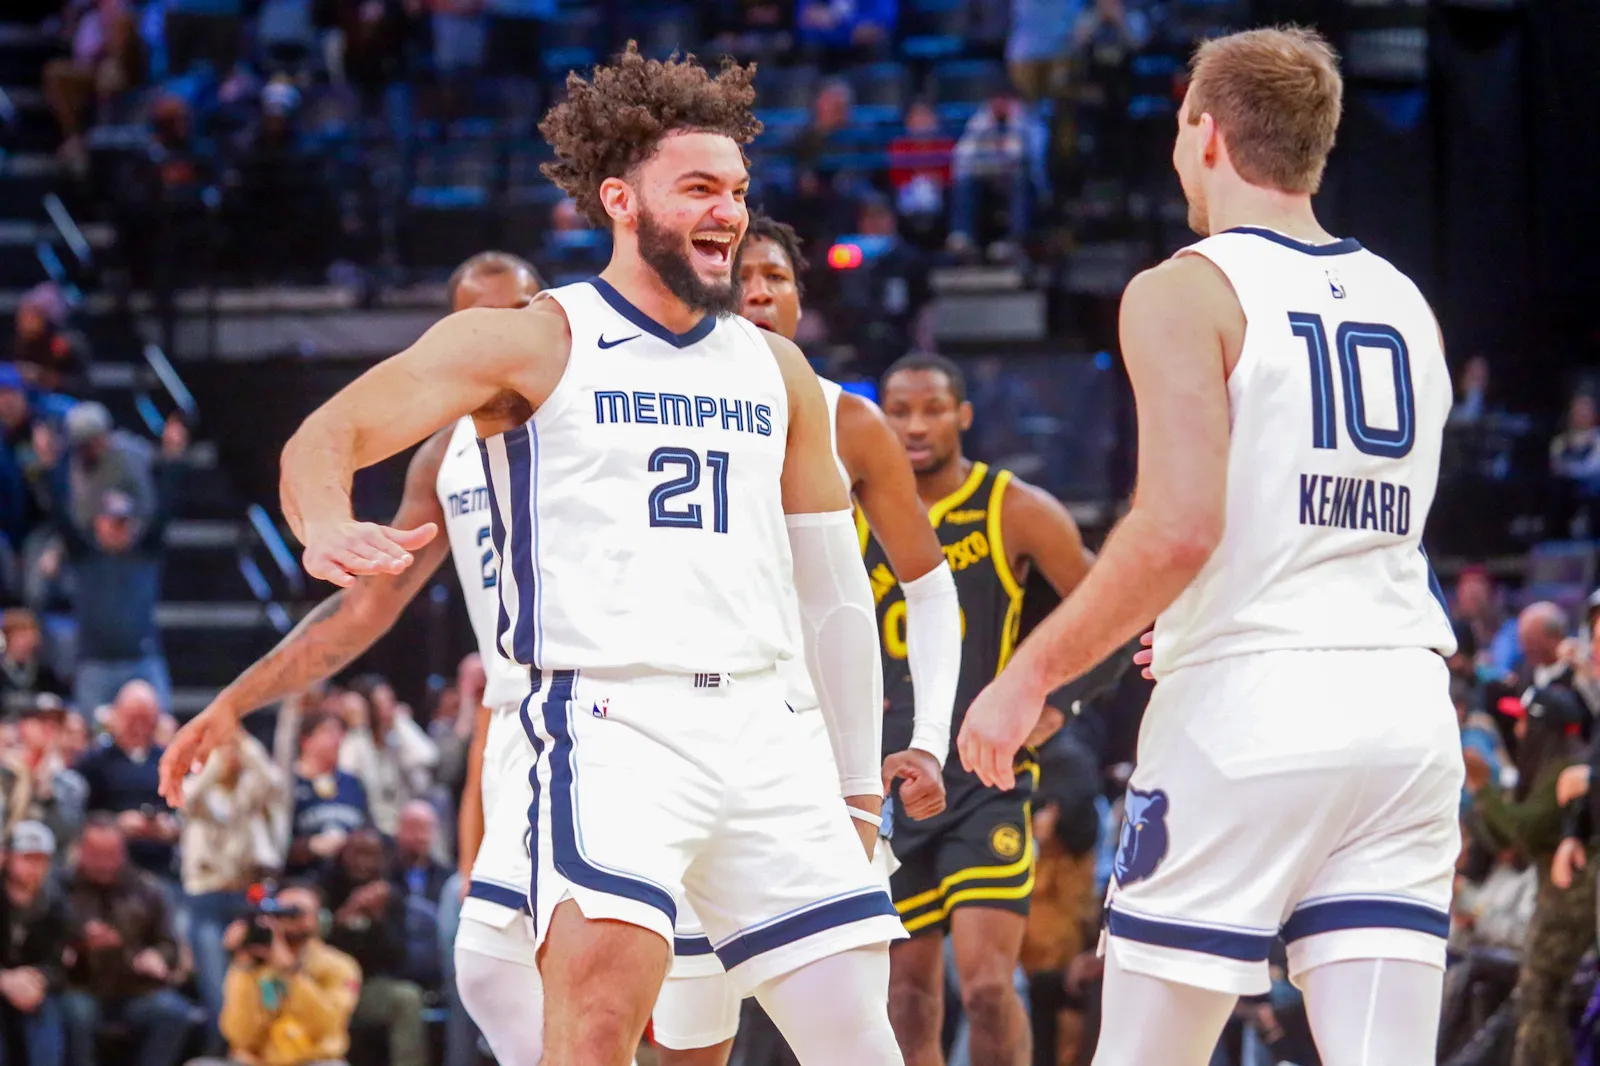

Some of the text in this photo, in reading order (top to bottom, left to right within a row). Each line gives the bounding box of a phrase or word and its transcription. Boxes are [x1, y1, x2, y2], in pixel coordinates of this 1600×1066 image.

[594, 390, 772, 437] MEMPHIS
[1286, 311, 1416, 459] 10
[647, 446, 730, 534] 21
[1299, 473, 1411, 536] KENNARD
